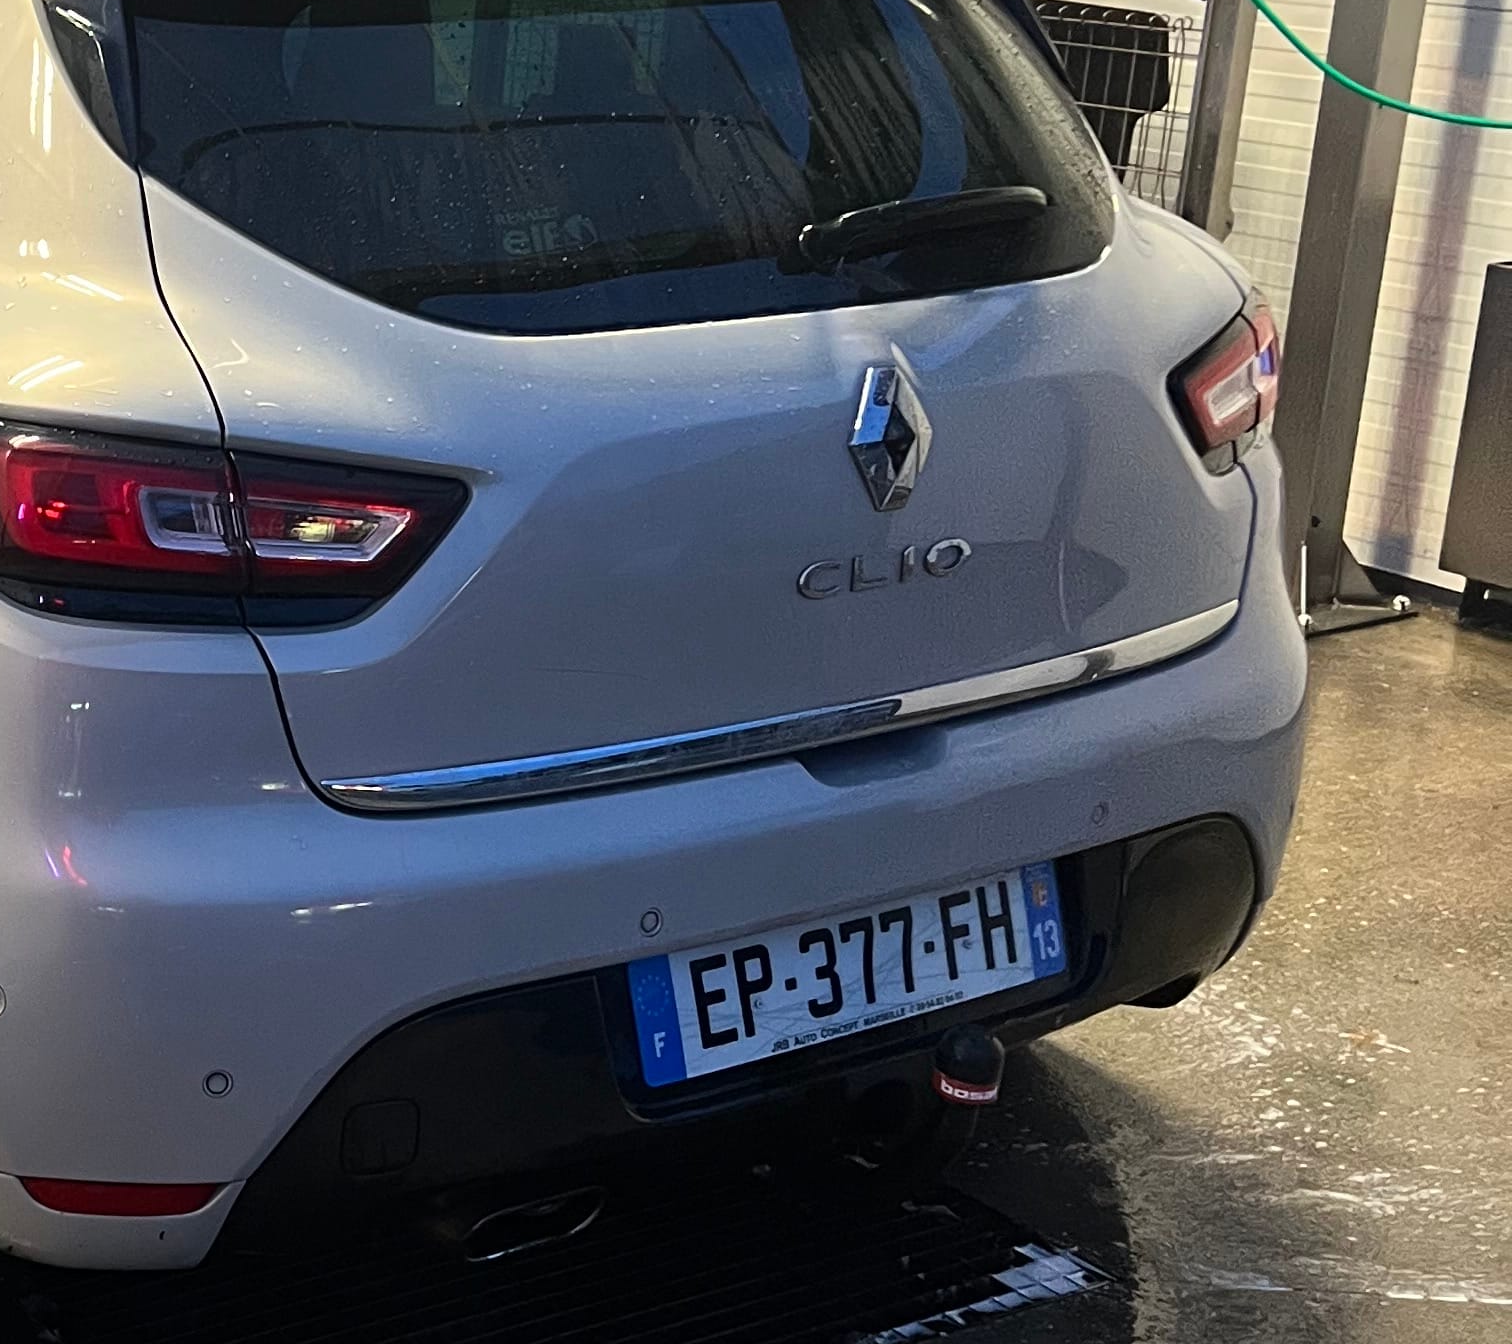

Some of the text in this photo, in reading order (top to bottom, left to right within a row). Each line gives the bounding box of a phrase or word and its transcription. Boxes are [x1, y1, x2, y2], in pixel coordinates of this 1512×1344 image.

[796, 537, 973, 600] CLIO
[653, 1031, 666, 1059] F
[1032, 919, 1061, 960] 13
